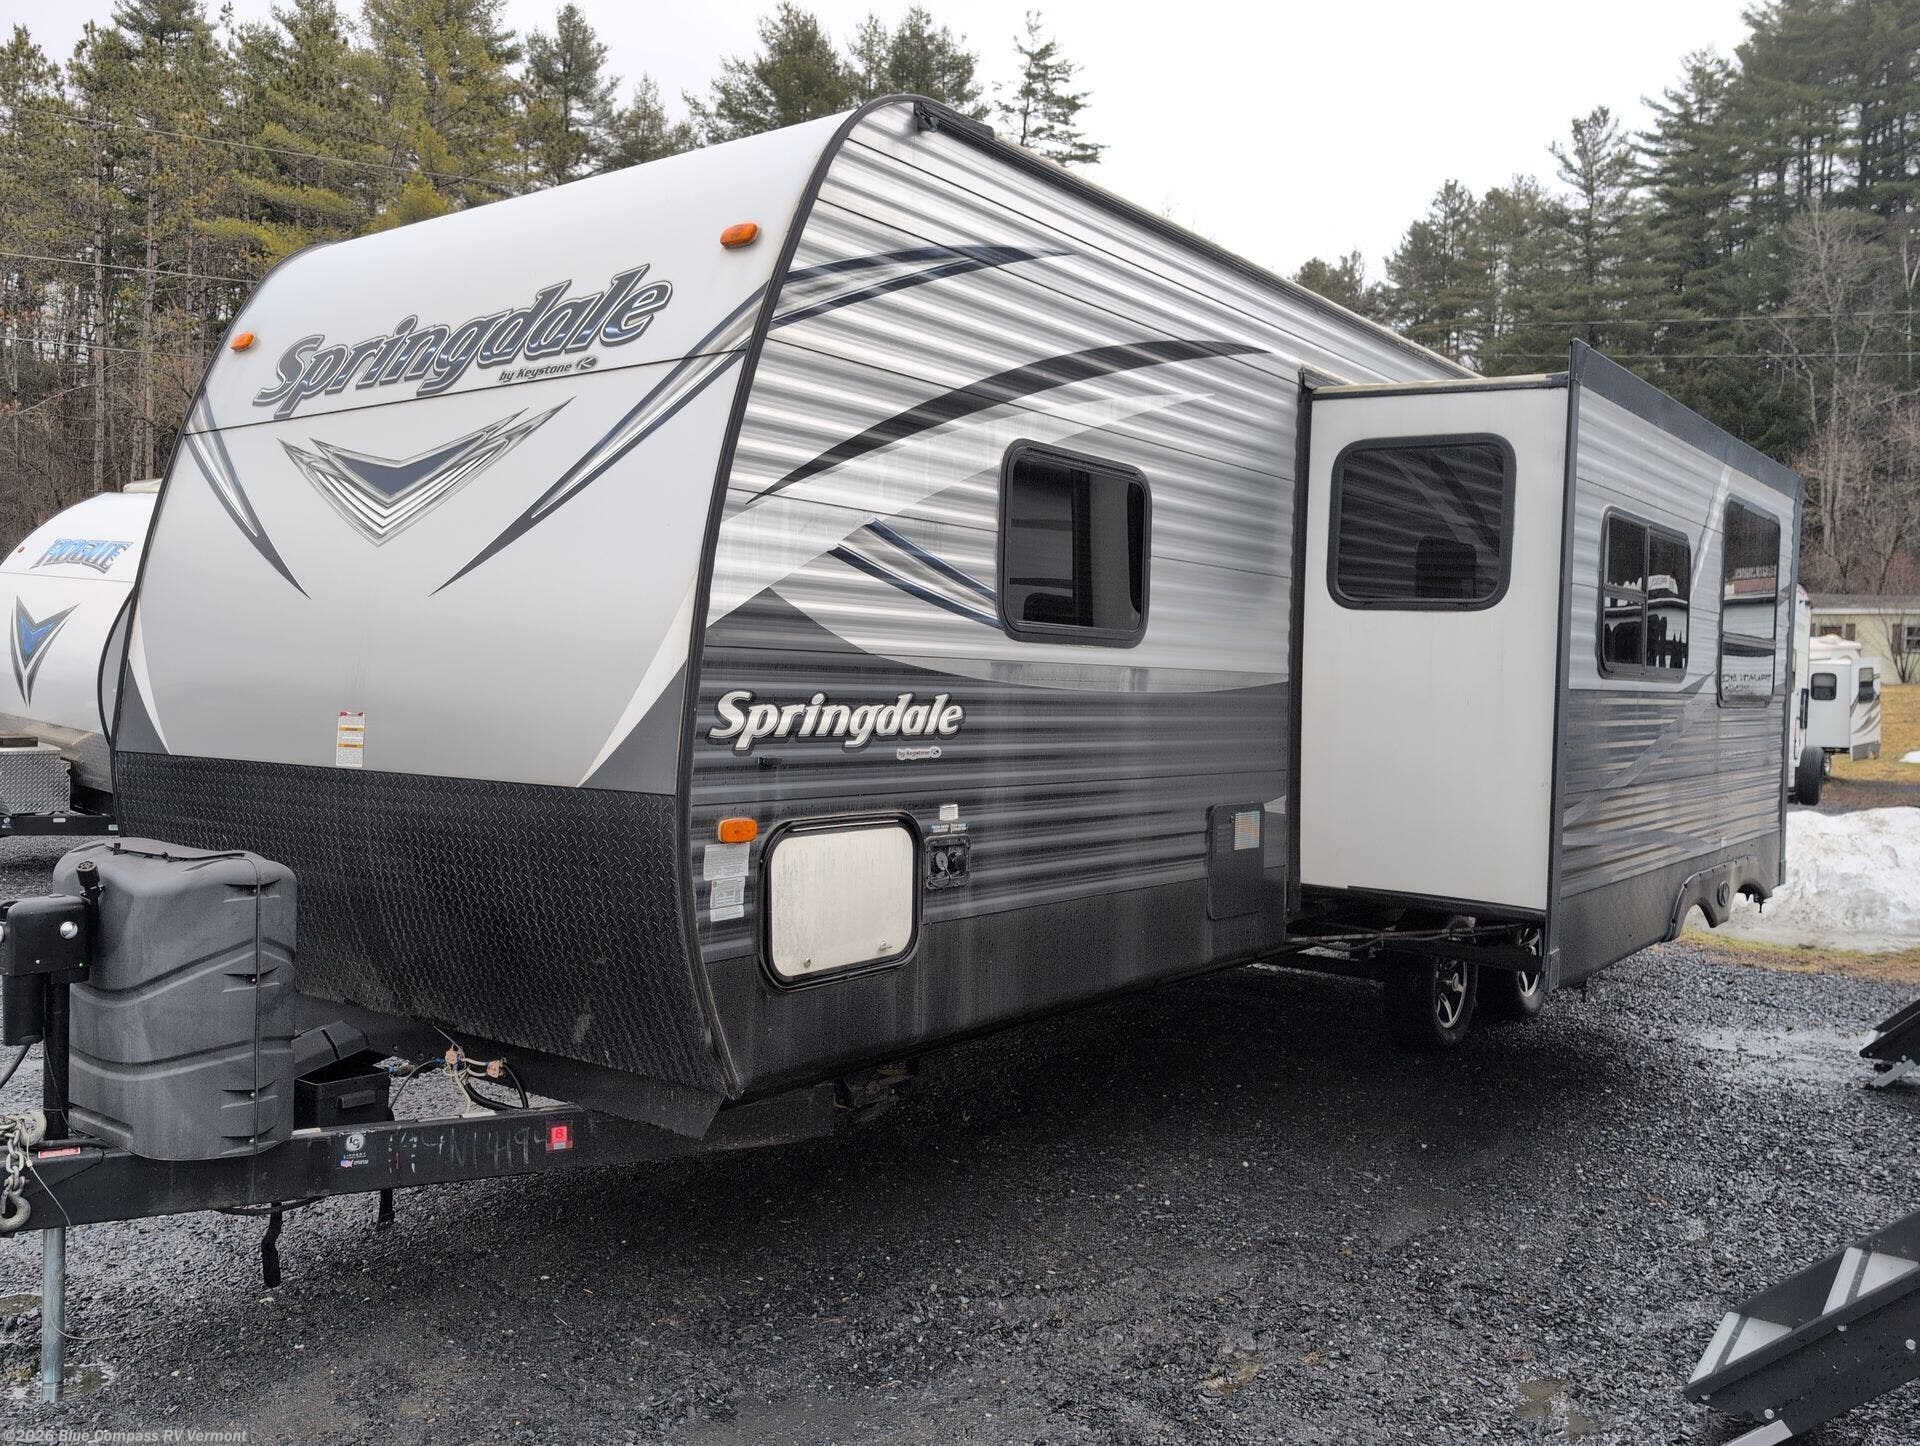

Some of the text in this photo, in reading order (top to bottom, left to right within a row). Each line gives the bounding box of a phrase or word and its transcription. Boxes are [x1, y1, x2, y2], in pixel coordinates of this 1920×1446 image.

[252, 263, 674, 420] Springdale
[499, 371, 515, 383] by
[516, 363, 573, 380] Keystone
[707, 689, 965, 751] Springdale
